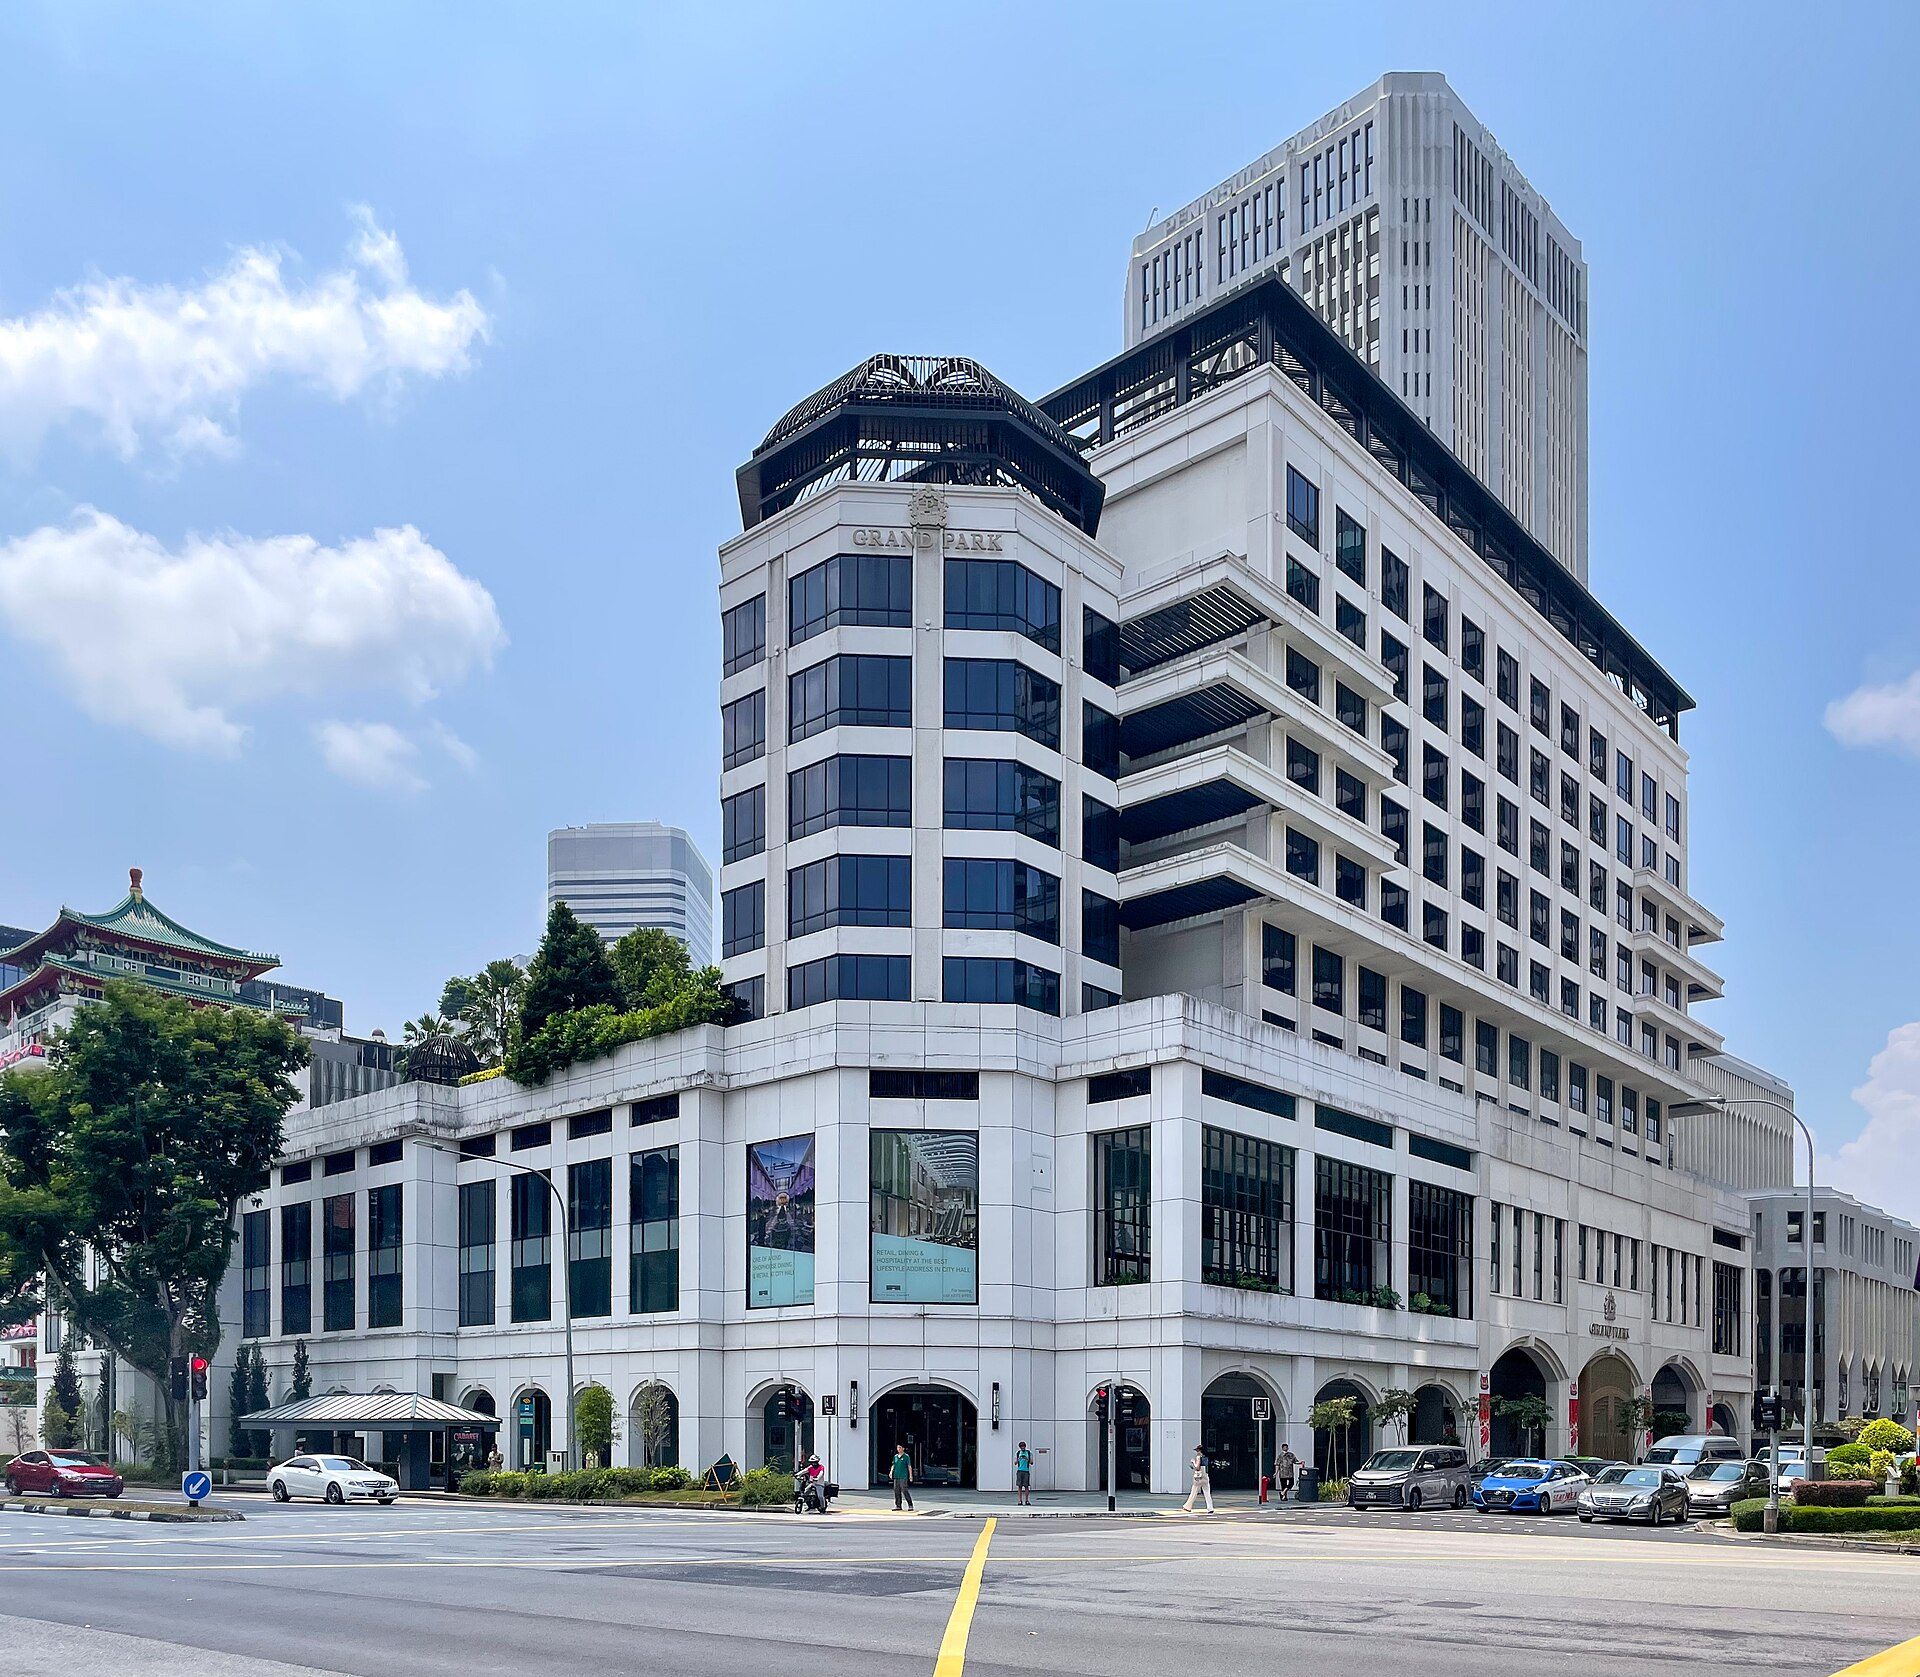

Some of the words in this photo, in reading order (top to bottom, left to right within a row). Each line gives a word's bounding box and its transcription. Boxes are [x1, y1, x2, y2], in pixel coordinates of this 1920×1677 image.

[1165, 157, 1274, 237] PENINSULA
[1285, 105, 1354, 154] PLAZA
[852, 529, 934, 548] GRAND
[942, 533, 1003, 552] PARK
[1589, 1323, 1611, 1338] GRAND
[1612, 1326, 1630, 1340] PARK
